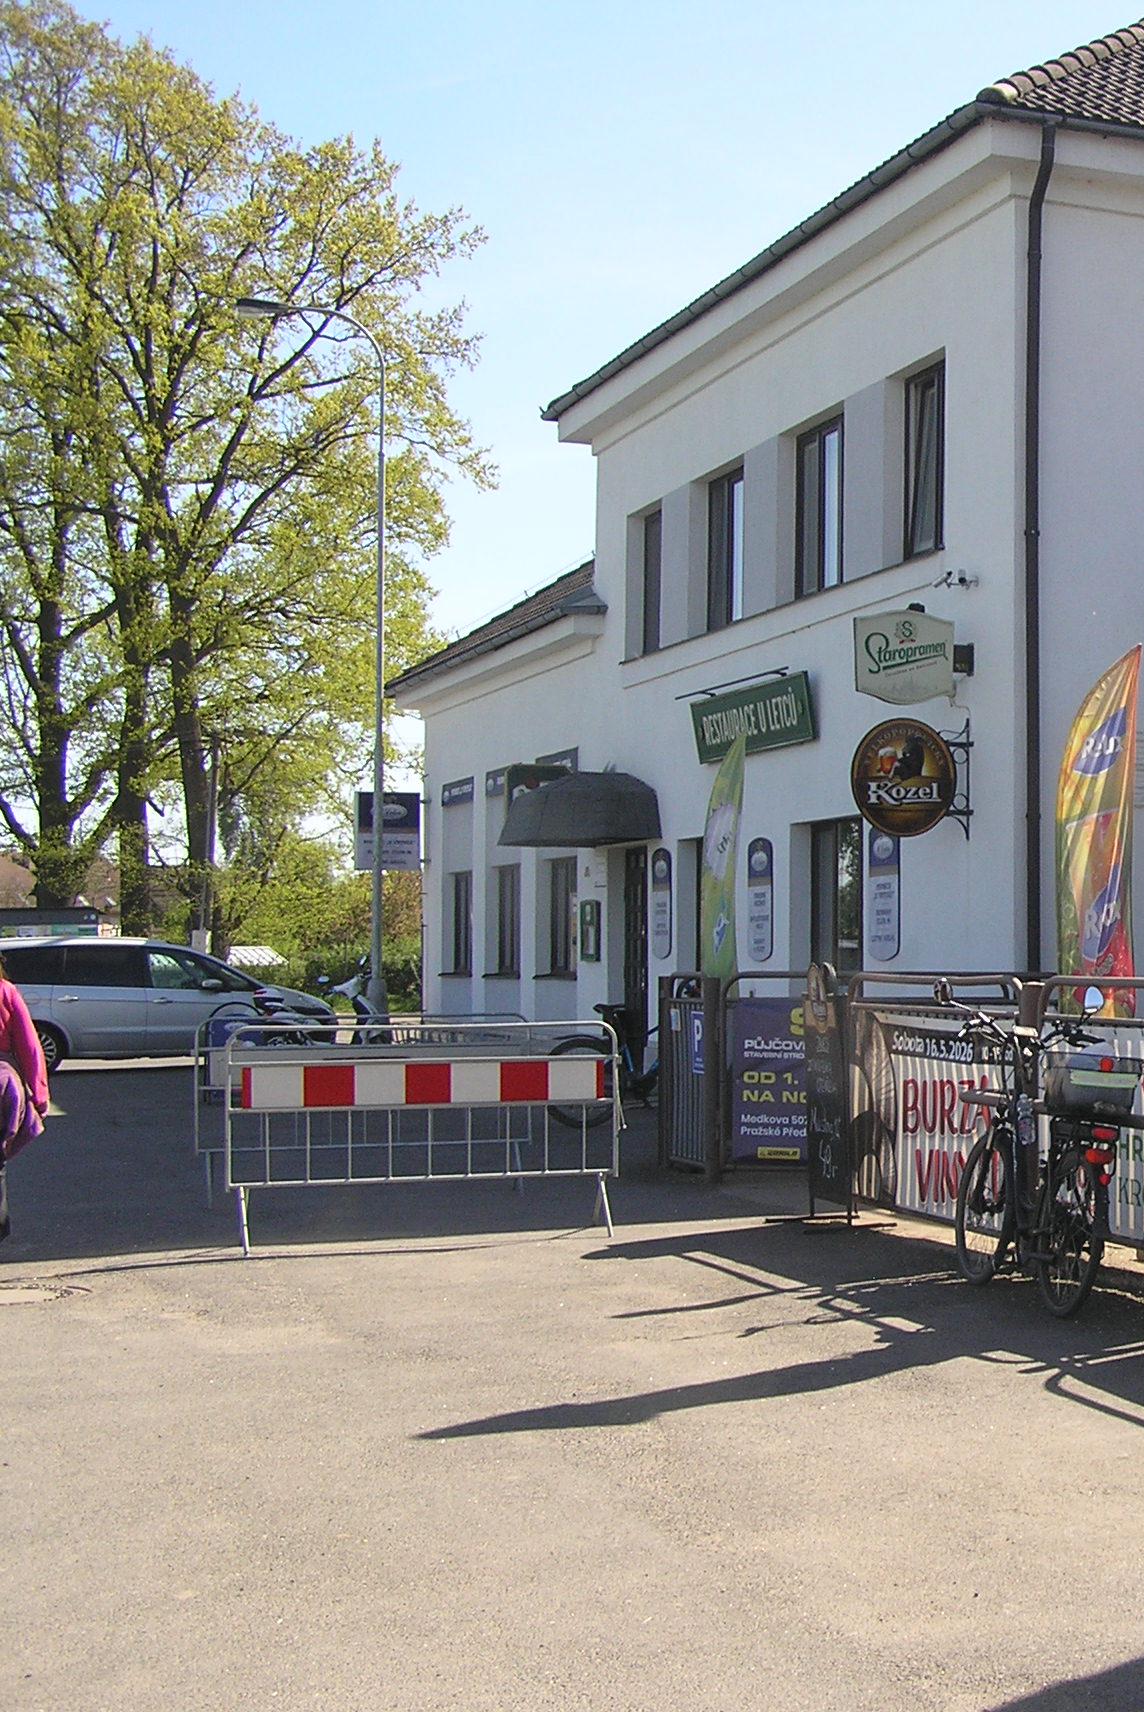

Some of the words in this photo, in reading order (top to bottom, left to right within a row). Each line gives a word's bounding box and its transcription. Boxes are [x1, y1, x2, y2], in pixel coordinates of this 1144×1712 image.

[865, 632, 948, 674] Staropramen
[702, 704, 758, 746] RESTAURACE
[757, 701, 766, 733] U
[868, 781, 941, 806] Kozel
[744, 1035, 806, 1050] PŮJČOV
[892, 1030, 925, 1053] Sobota
[925, 1037, 974, 1062] 16.5.2026
[783, 1051, 806, 1060] STRO
[743, 1071, 777, 1085] OD
[783, 1072, 799, 1085] 1.
[742, 1089, 775, 1103] NA
[903, 1075, 992, 1135] BURZA
[740, 1113, 789, 1124] Medkova
[740, 1126, 781, 1137] Pražské
[782, 1126, 808, 1138] Před
